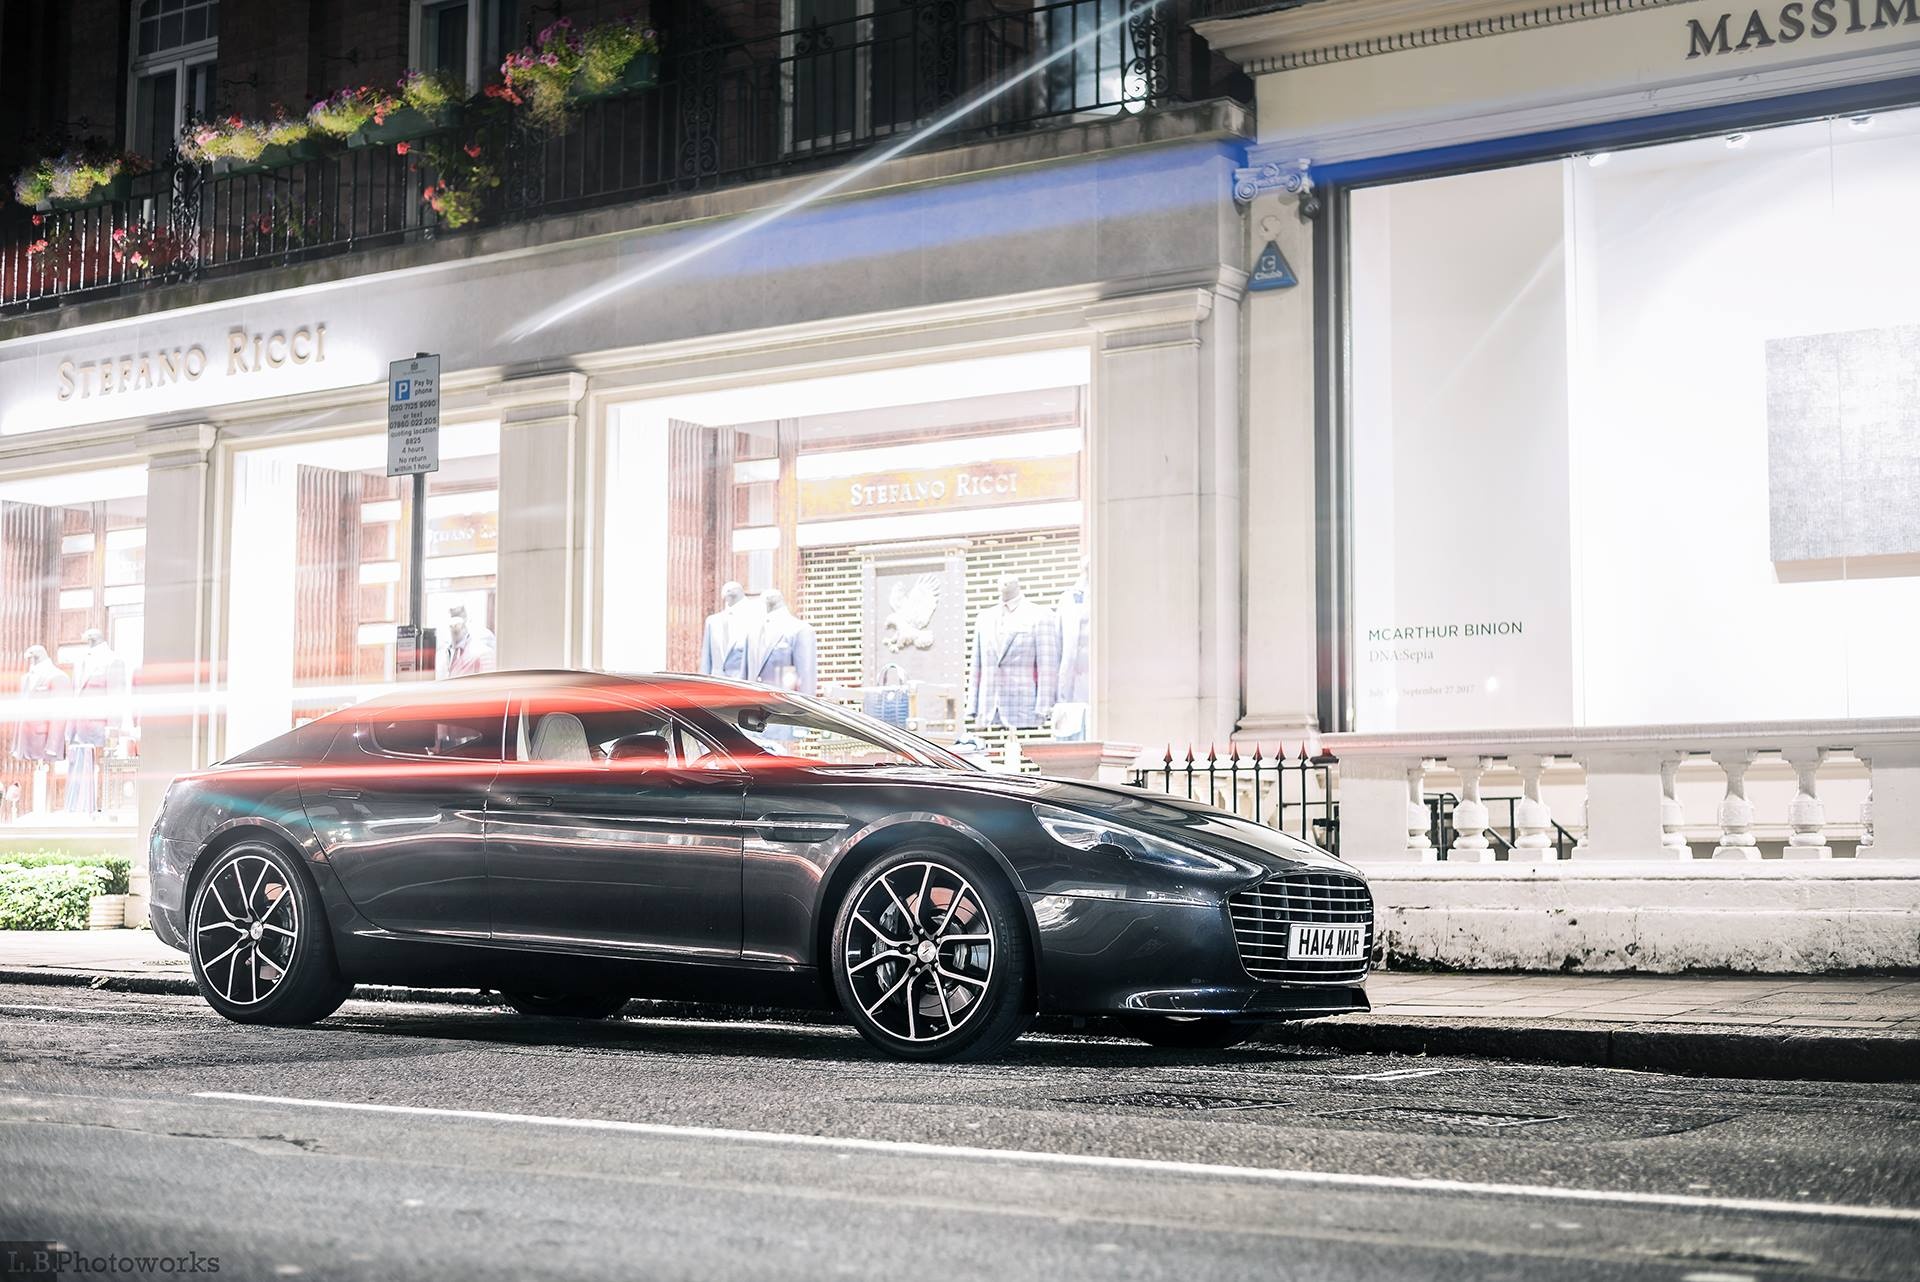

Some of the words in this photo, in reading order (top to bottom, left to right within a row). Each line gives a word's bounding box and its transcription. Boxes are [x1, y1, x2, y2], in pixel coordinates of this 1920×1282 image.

[1686, 0, 1920, 58] MASSIM
[57, 345, 207, 401] STEFANO
[226, 322, 327, 375] RICCI
[414, 380, 425, 388] Pay
[426, 379, 433, 387] by
[415, 388, 432, 396] phone
[391, 403, 403, 412] 020
[403, 412, 411, 420] or
[411, 419, 422, 428] 022
[424, 417, 437, 426] 205
[413, 426, 437, 436] location
[408, 445, 424, 453] hours
[399, 456, 407, 464] No
[408, 454, 427, 463] return
[394, 464, 412, 473] within
[417, 462, 431, 471] hour
[849, 480, 946, 506] STEFANO
[956, 472, 1018, 496] RICCI
[1368, 624, 1459, 641] MCARTHUR
[1464, 621, 1523, 637] BINION
[1299, 929, 1334, 955] HA14
[1337, 930, 1359, 955] MAR
